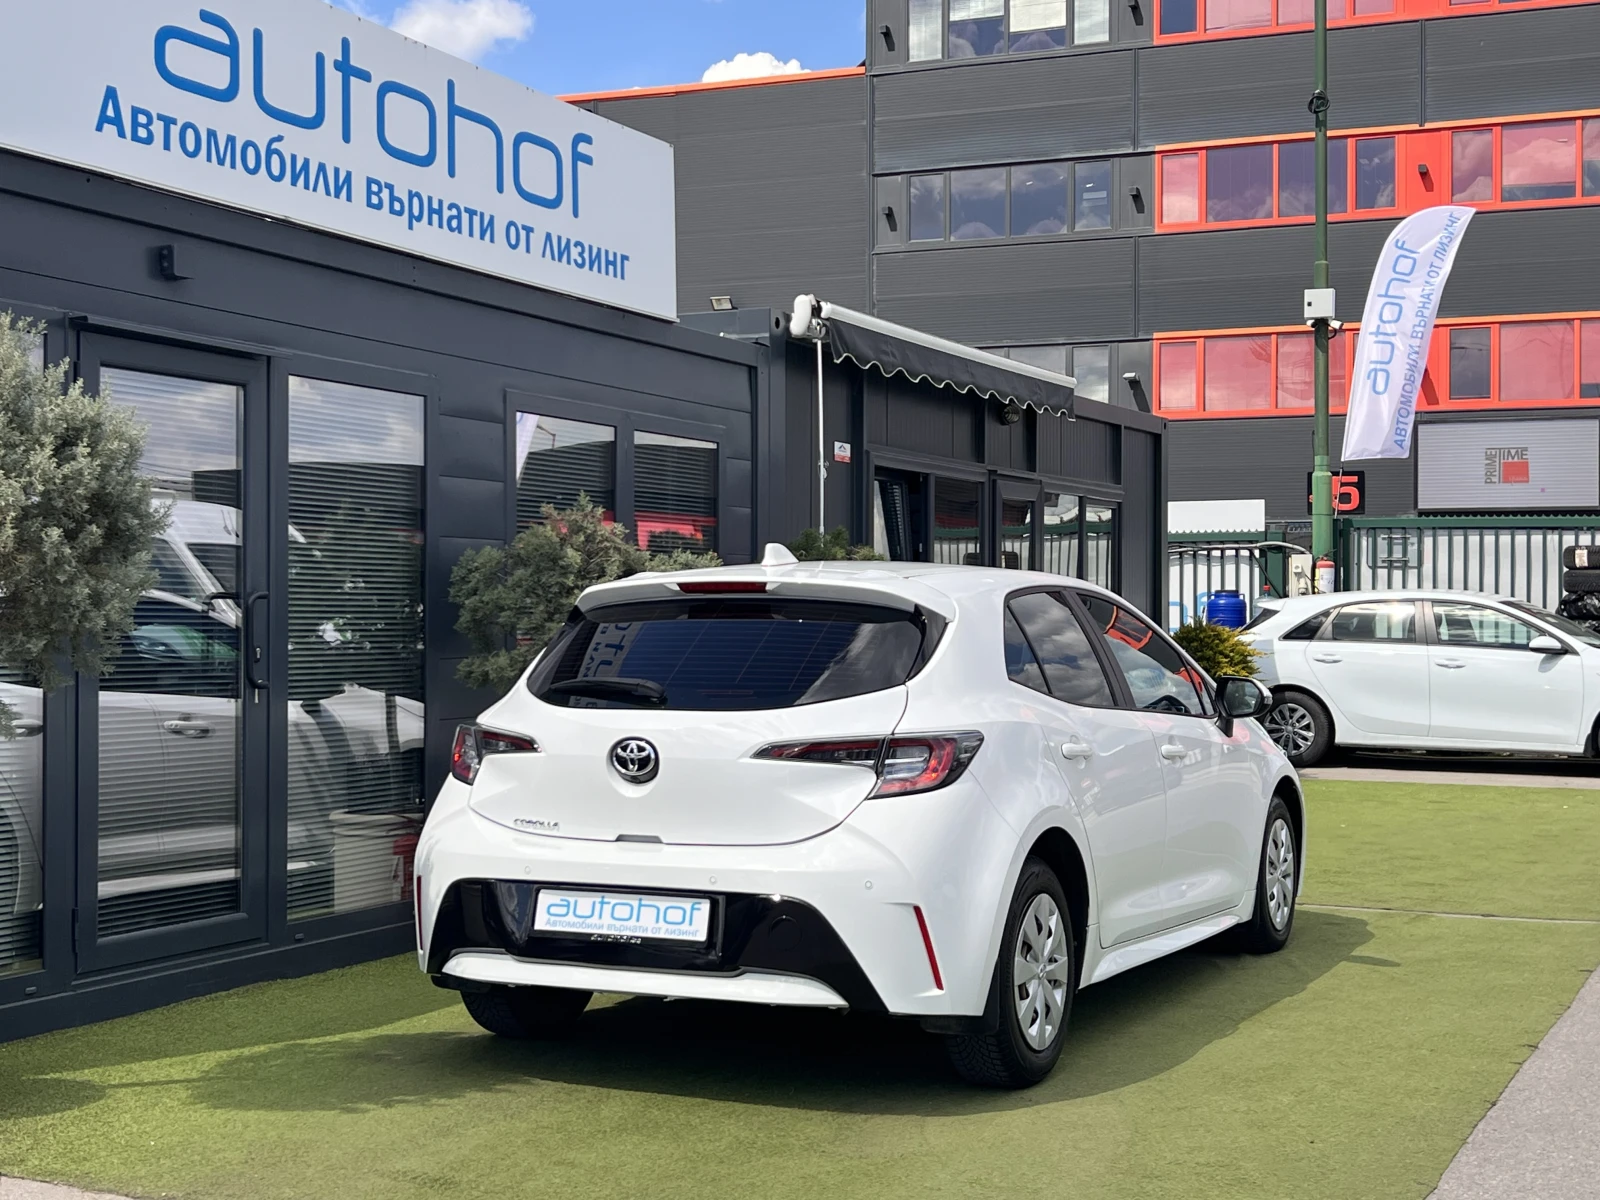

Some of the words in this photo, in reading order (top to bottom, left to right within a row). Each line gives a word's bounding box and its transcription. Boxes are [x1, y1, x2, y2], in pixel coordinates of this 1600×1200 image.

[95, 85, 352, 202] Автомобили
[366, 176, 495, 244] върнати
[505, 219, 535, 255] от
[541, 235, 630, 281] лизинг
[153, 8, 594, 218] autohof
[1367, 238, 1420, 395] autohof
[1393, 344, 1422, 450] АВТОМОБИЛИ
[1427, 261, 1443, 279] ОТ
[1484, 449, 1498, 484] PRIME
[545, 918, 604, 930] Автомобили
[607, 923, 649, 934] върнати
[651, 926, 662, 935] от
[664, 927, 700, 938] лизинг
[546, 895, 702, 926] autohof
